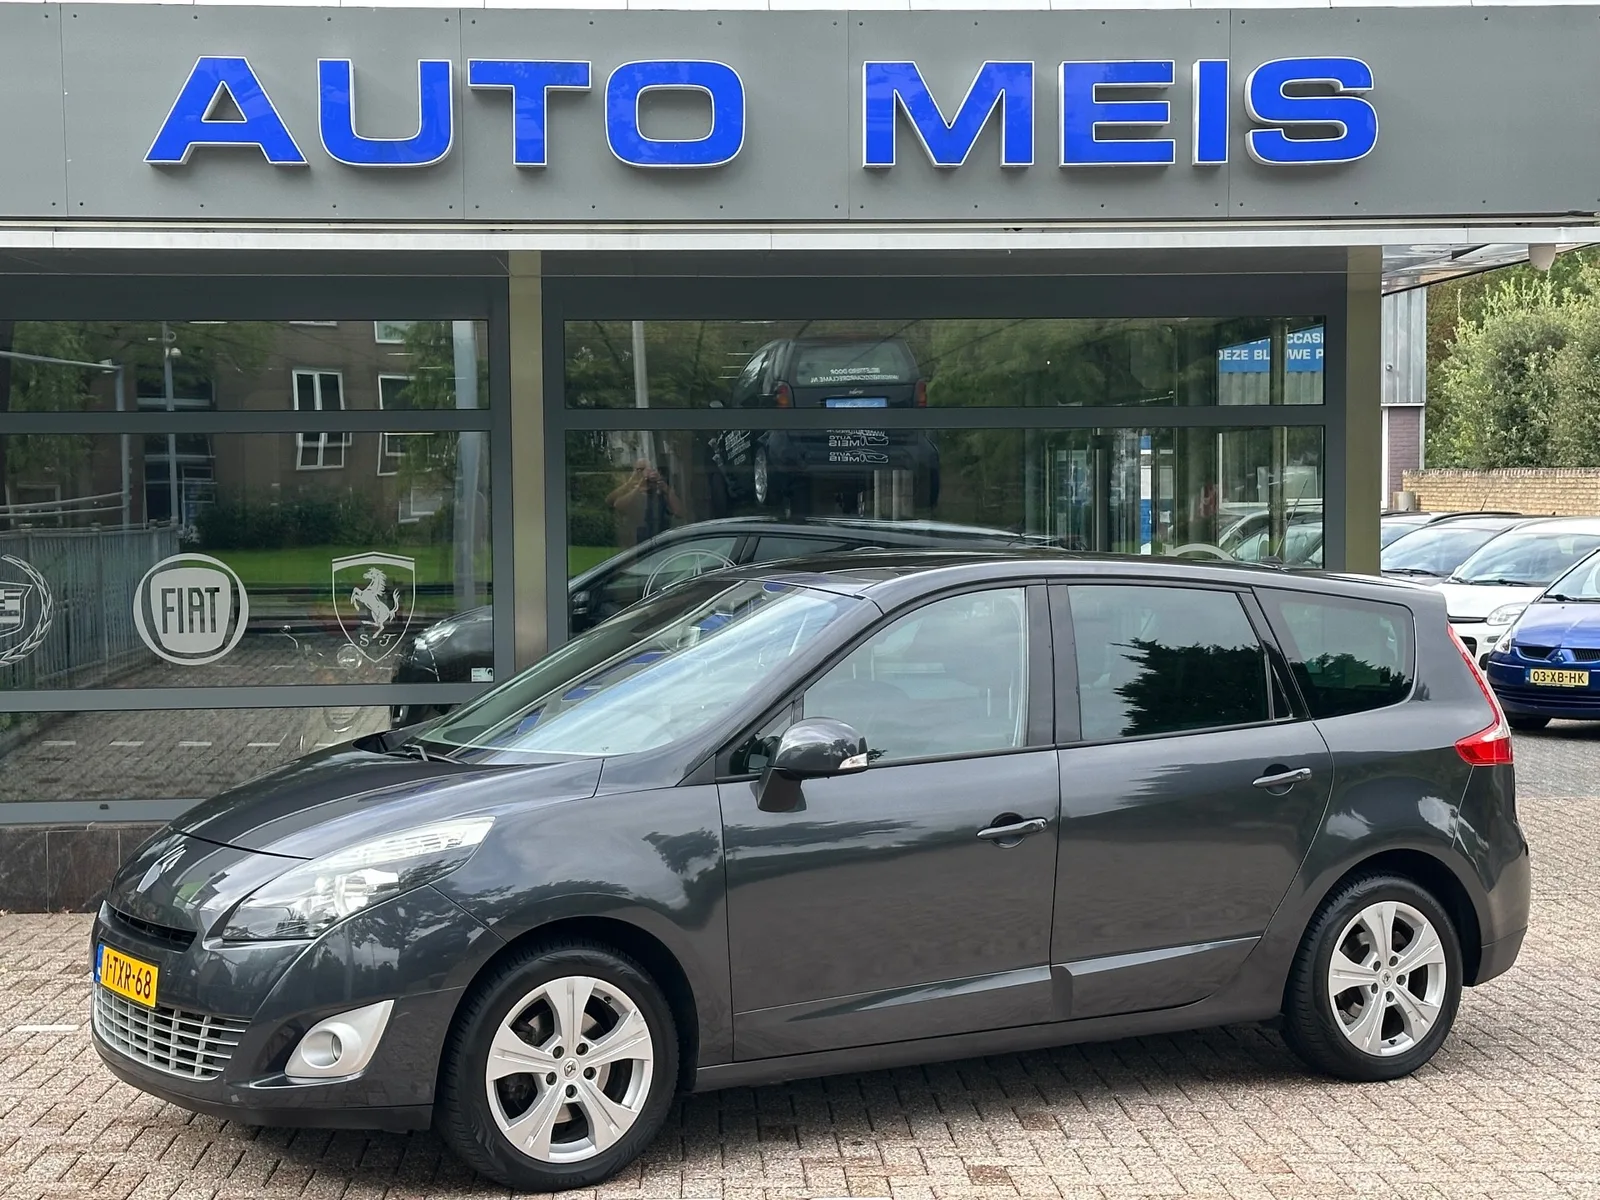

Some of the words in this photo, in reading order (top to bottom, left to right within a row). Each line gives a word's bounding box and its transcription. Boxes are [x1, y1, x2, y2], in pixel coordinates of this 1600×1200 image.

[143, 55, 747, 169] AUTO
[862, 56, 1379, 168] MEIS
[1253, 349, 1311, 360] BLWE
[161, 586, 221, 635] FIAT
[359, 634, 369, 647] S
[1533, 670, 1585, 684] 03-XB-HK
[105, 953, 152, 999] 1-TXR-68
